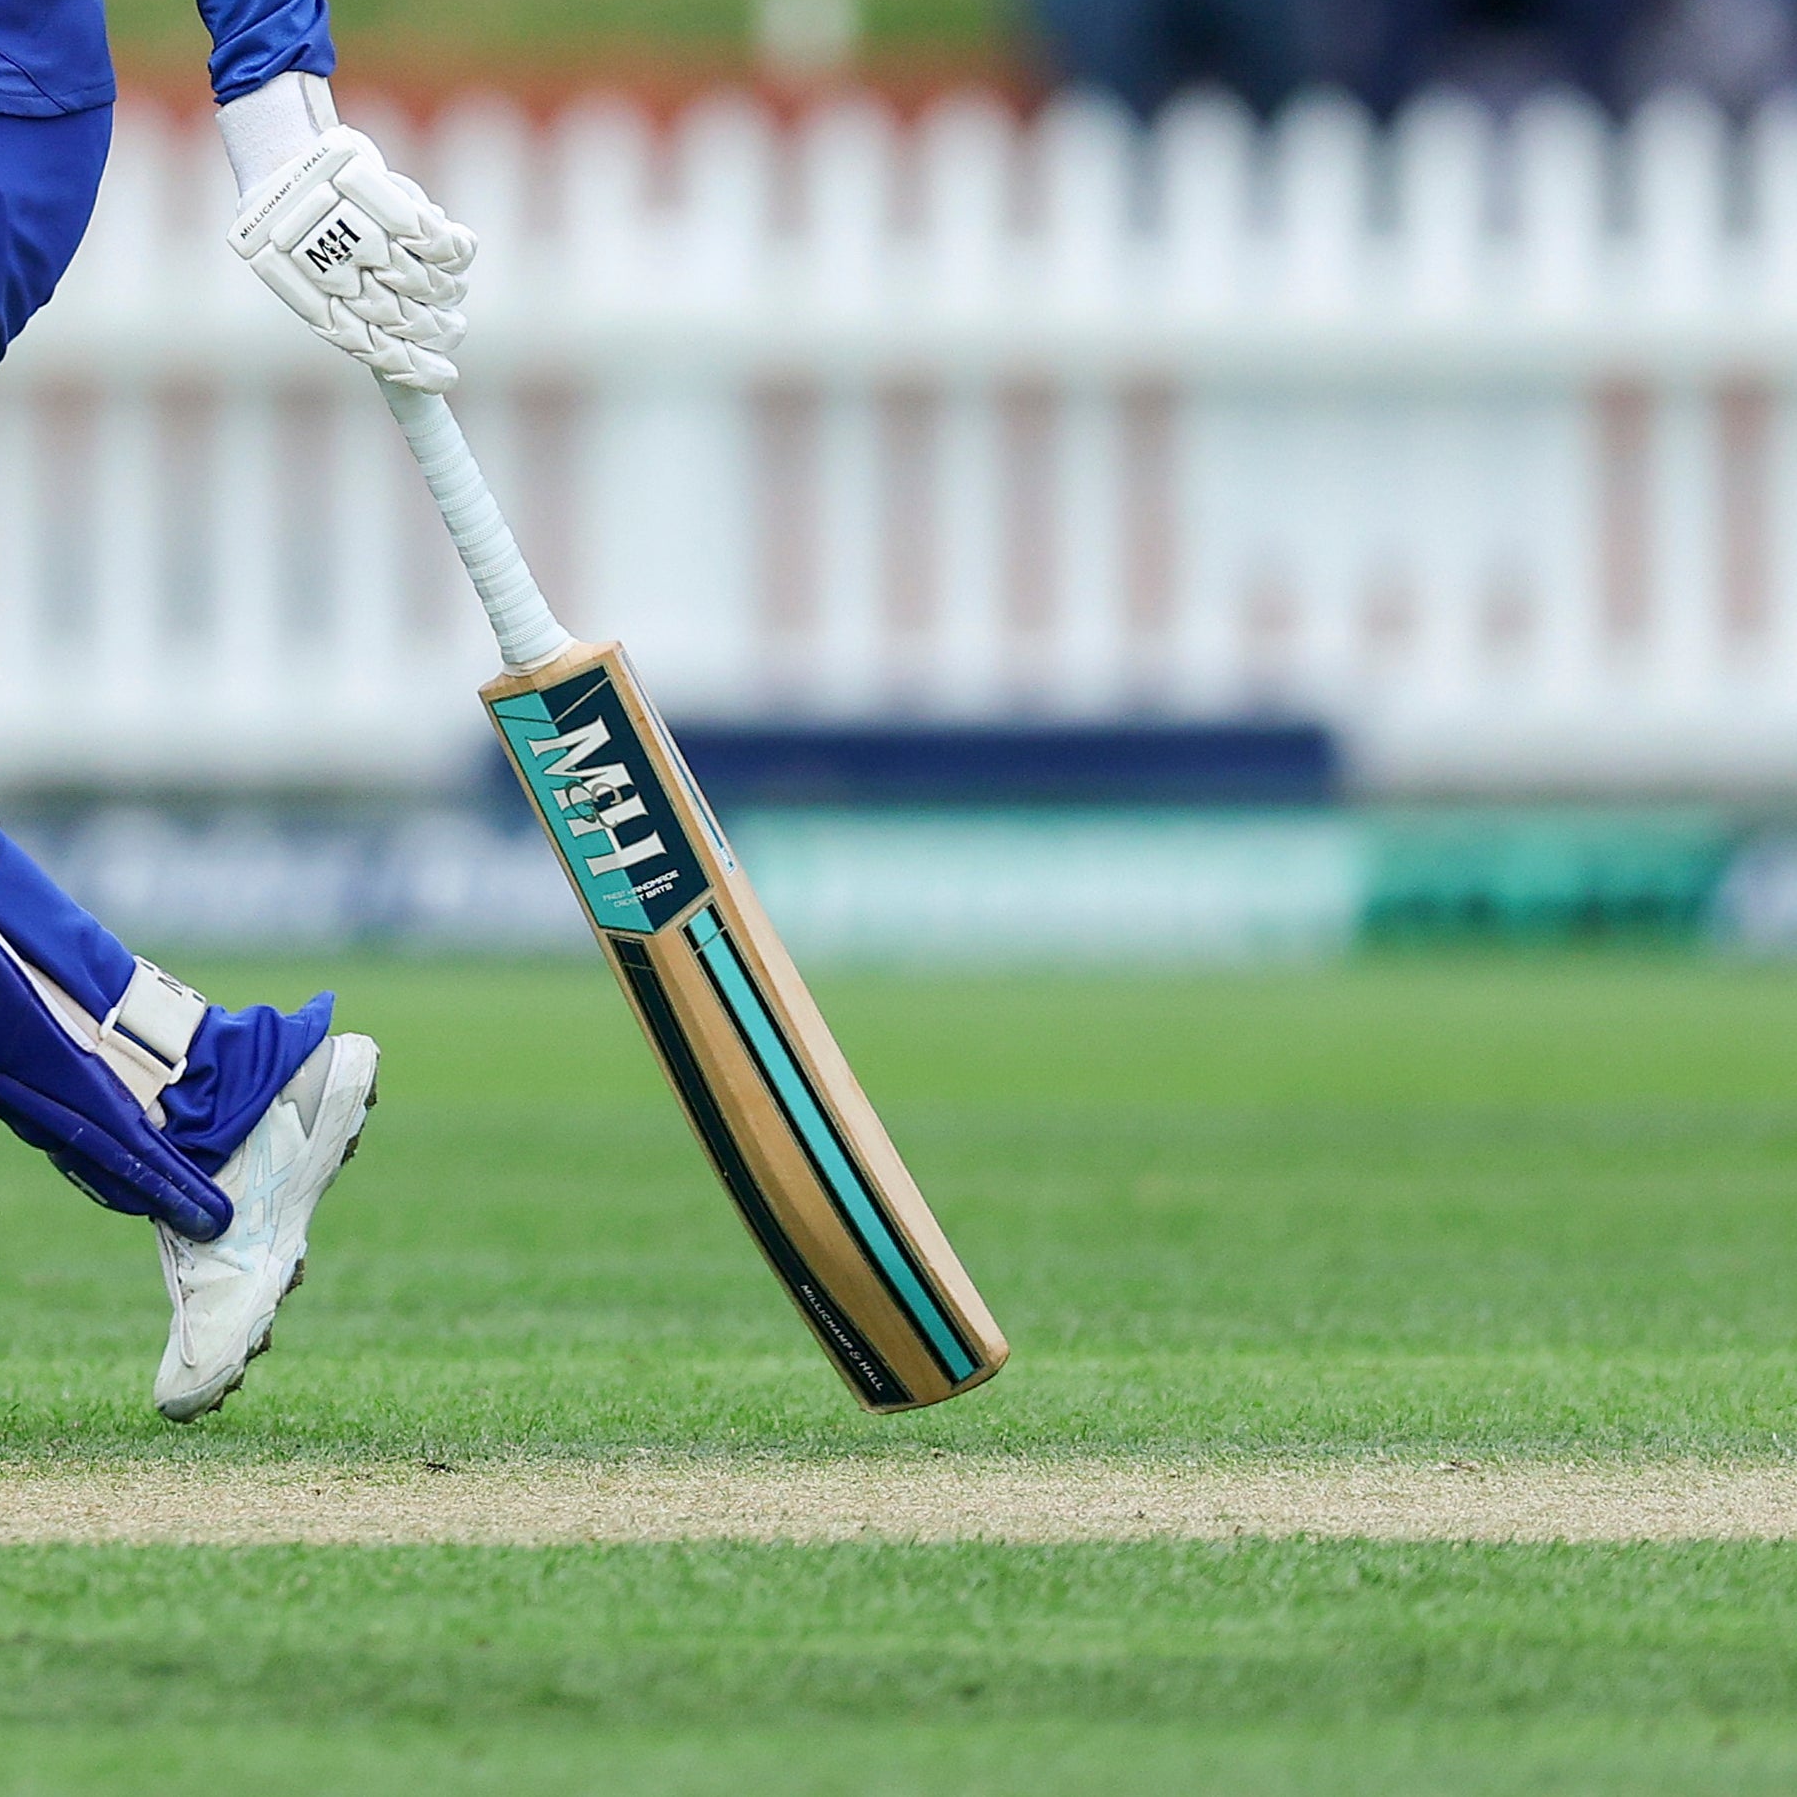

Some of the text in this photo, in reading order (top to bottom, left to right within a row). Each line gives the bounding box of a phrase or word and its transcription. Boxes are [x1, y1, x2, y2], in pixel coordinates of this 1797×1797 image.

[239, 181, 293, 241] MILLICHAMP
[302, 146, 330, 173] HALL
[800, 1284, 853, 1350] MILLICHAMP
[858, 1361, 884, 1391] HALL
